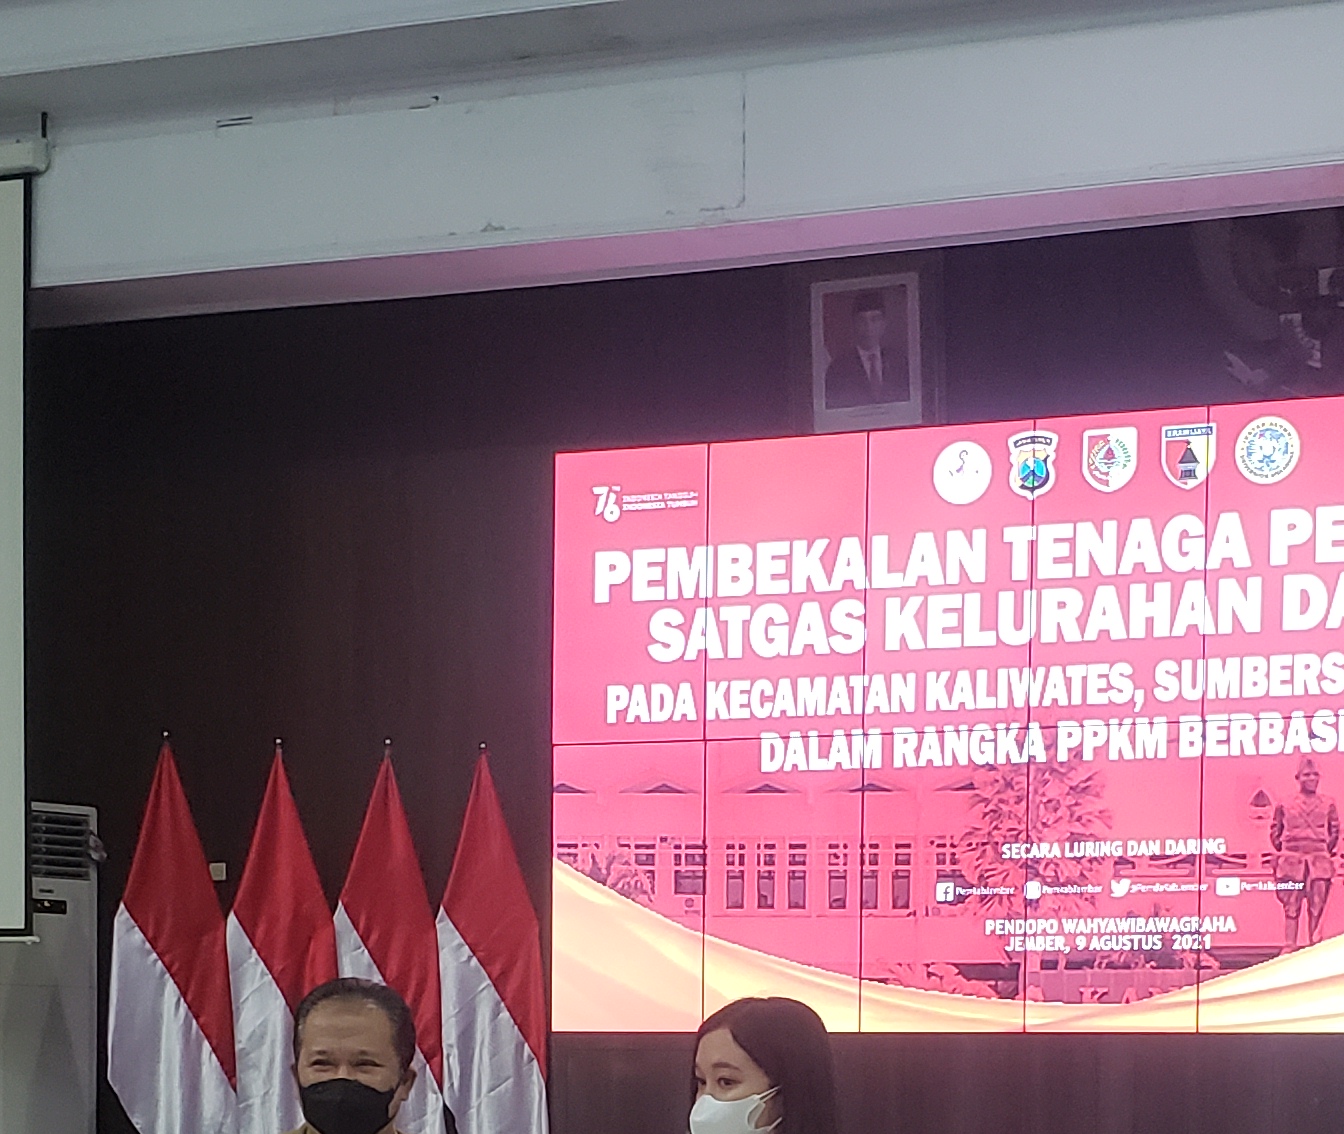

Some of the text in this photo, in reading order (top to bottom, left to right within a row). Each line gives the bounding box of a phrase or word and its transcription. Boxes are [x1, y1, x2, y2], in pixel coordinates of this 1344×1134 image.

[594, 528, 987, 603] PEMBEKALAN
[1003, 511, 1252, 581] TENAGA
[647, 600, 867, 663] SATGAS
[884, 577, 1261, 652] KELURAHAN
[606, 682, 697, 723] PADA
[706, 674, 916, 720] KECAMATAN
[927, 663, 1145, 713] KALIWATES,
[759, 731, 882, 773] DALAM
[892, 722, 1047, 768] RANGKA
[1057, 717, 1168, 763] PPKM
[1002, 837, 1226, 859] SECARA LURING DAN DARING
[986, 915, 1236, 936] PENDOPO WAHYAWIBAWAGRAHA
[1004, 935, 1070, 953] JEMBER,
[1075, 934, 1087, 950] 9
[1089, 933, 1162, 951] AGUSTUS
